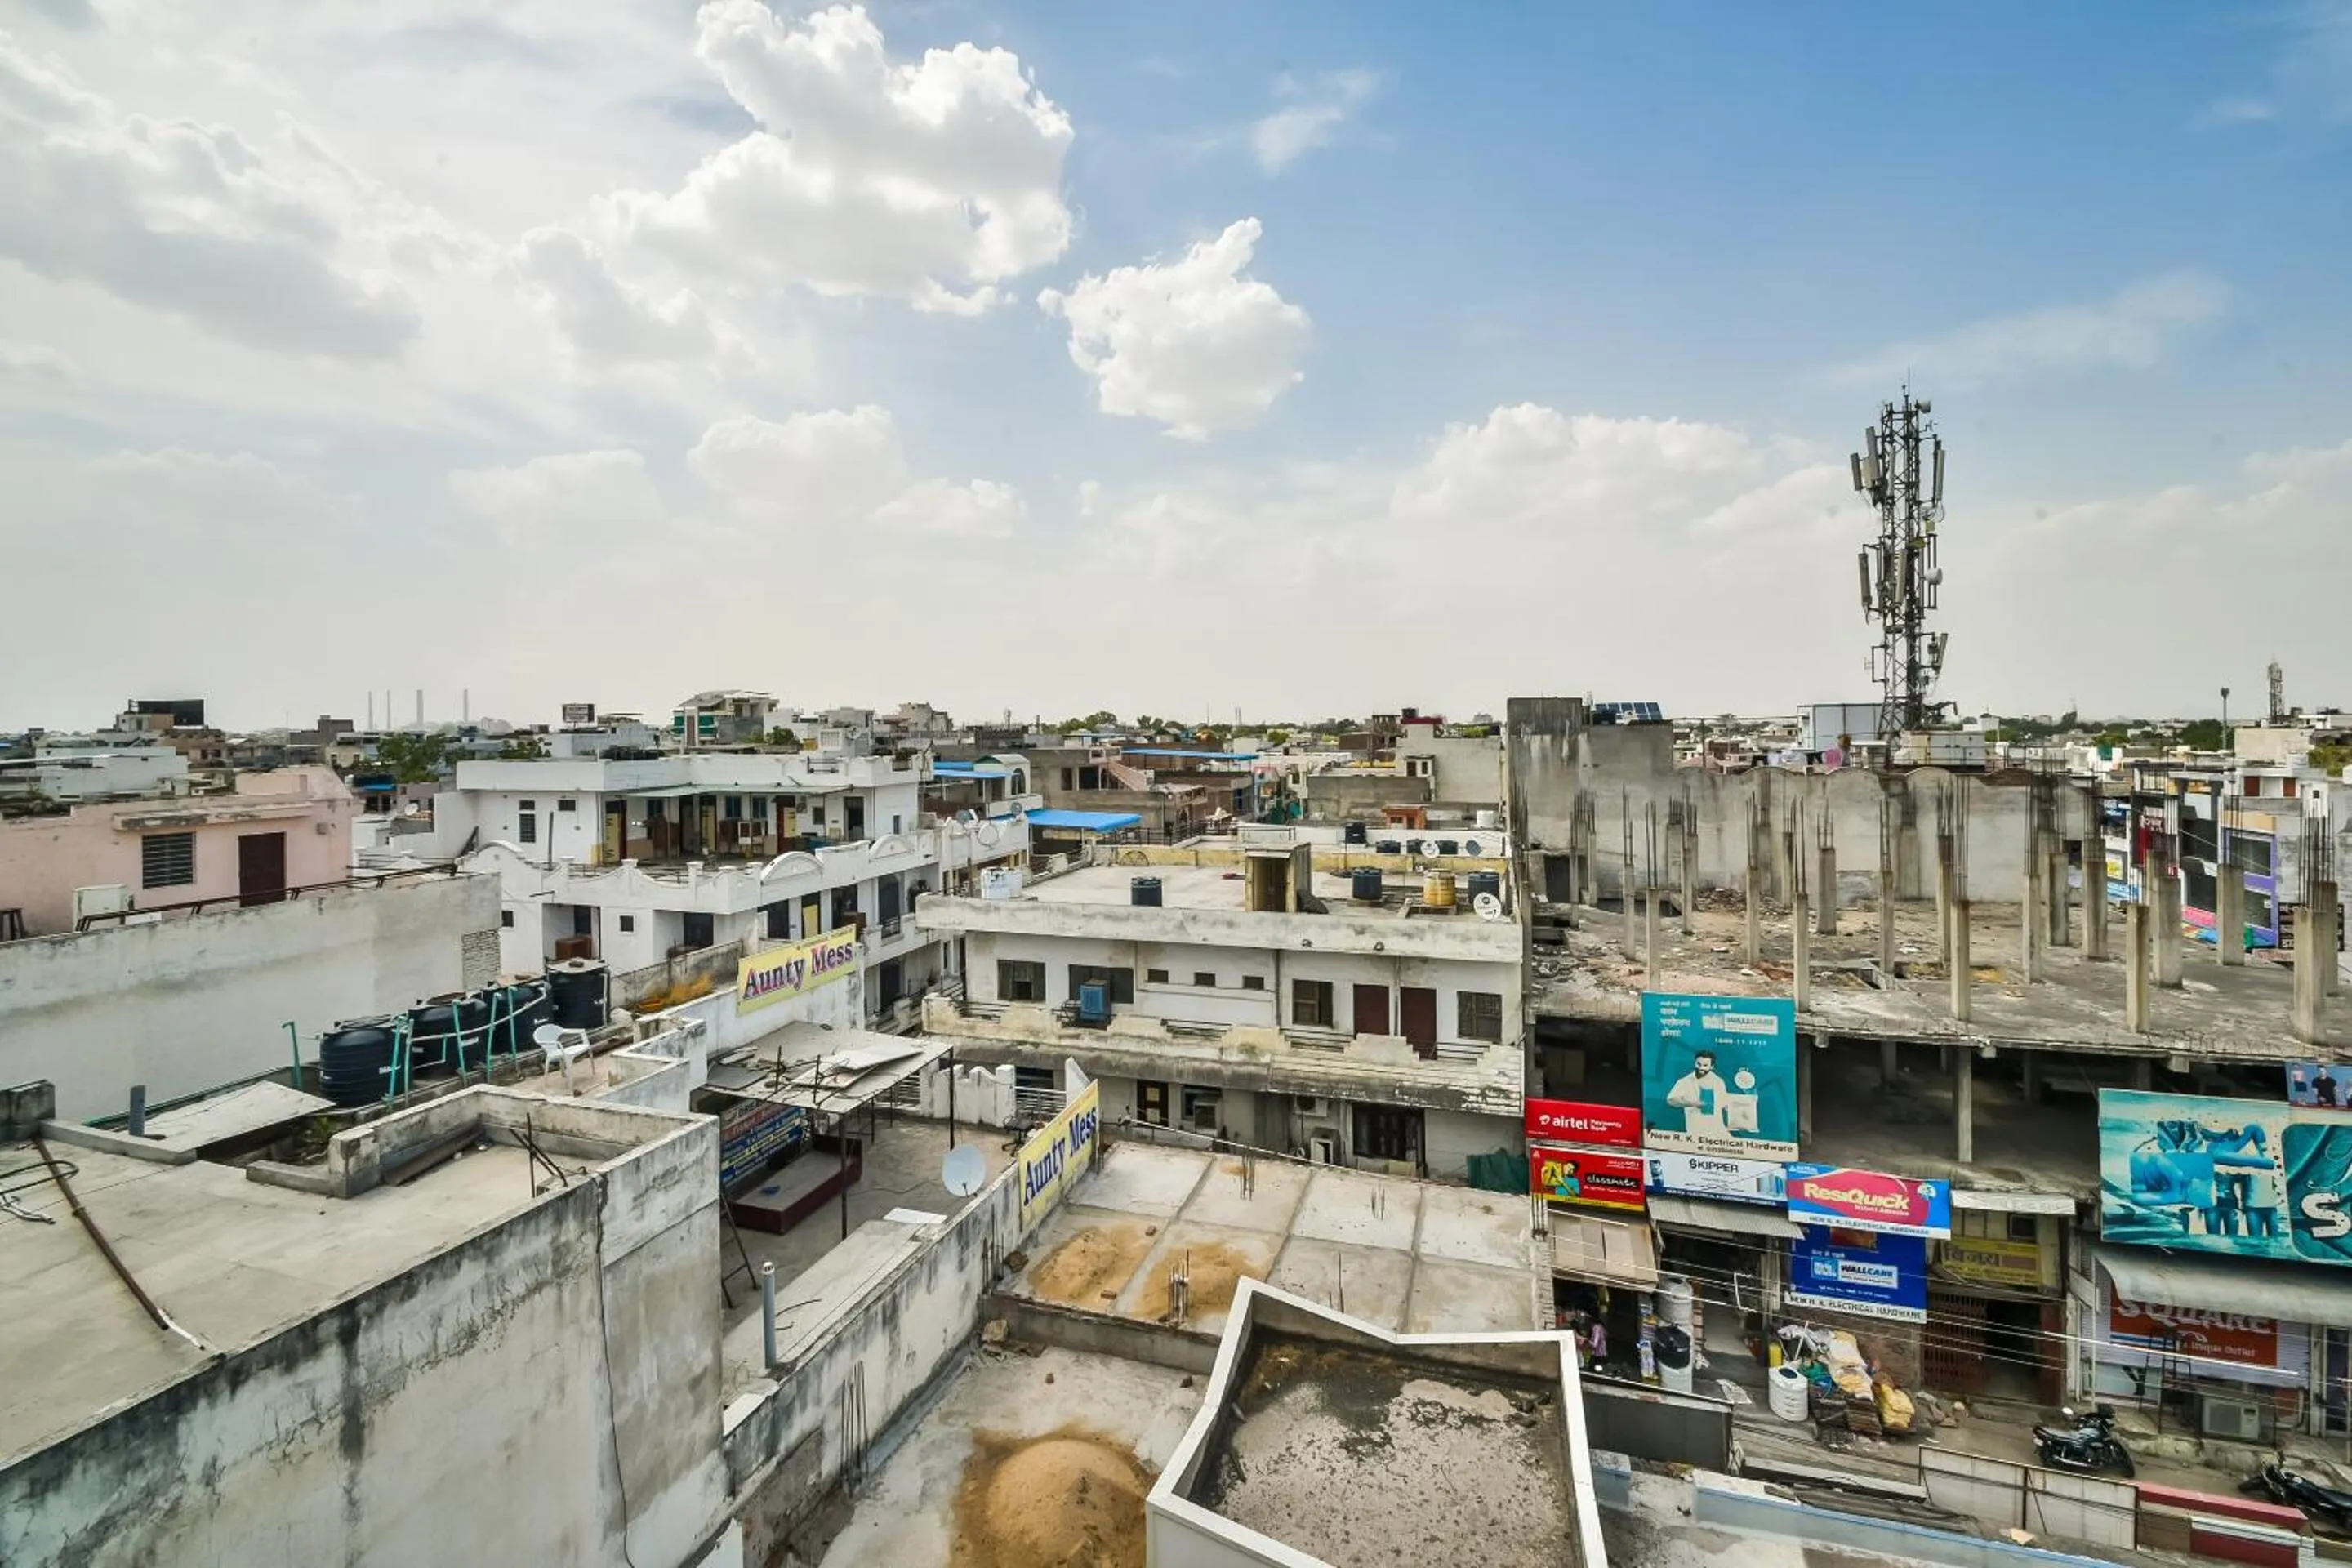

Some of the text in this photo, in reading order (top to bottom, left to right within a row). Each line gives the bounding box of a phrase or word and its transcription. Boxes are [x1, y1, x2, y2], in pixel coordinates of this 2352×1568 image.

[743, 942, 853, 999] Aunty Mess
[1552, 1116, 1588, 1130] airtel
[1650, 1132, 1671, 1141] New
[1699, 1136, 1743, 1148] Electrical
[1746, 1142, 1793, 1153] Hardware
[1023, 1136, 1065, 1206] Aunty
[1069, 1107, 1096, 1157] Mess
[1690, 1158, 1739, 1173] SKIPPER
